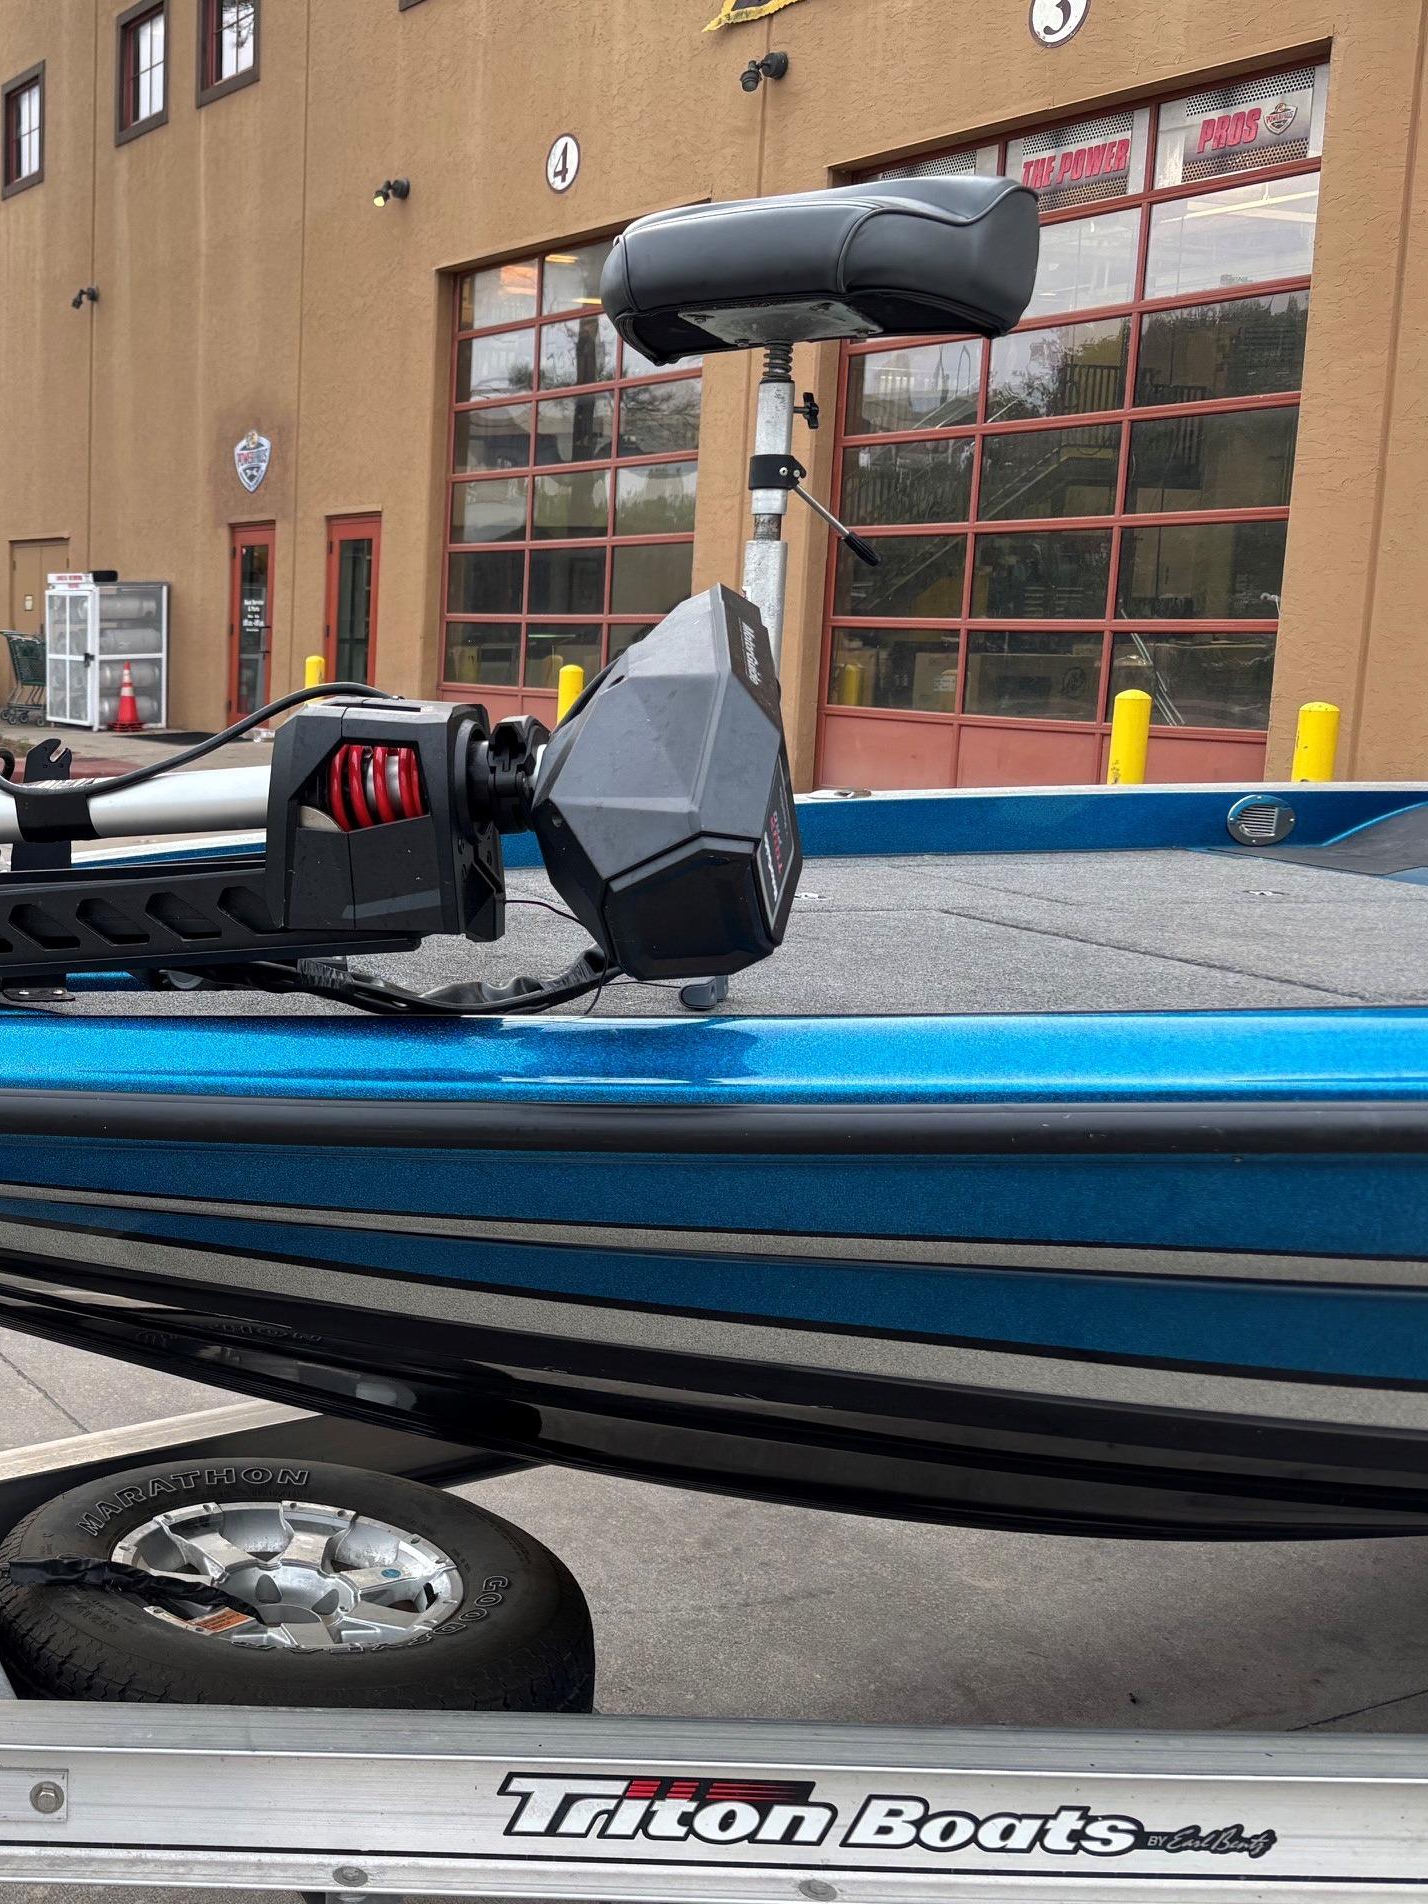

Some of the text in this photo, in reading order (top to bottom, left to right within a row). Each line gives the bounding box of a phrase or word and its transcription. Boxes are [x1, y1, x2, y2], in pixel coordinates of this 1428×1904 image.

[553, 141, 569, 183] 4
[1022, 107, 1262, 189] THE POWER PROS
[77, 1467, 309, 1536] MARATHON
[502, 1774, 836, 1843] Triton
[842, 1797, 1142, 1855] Boats
[1147, 1835, 1168, 1847] BY
